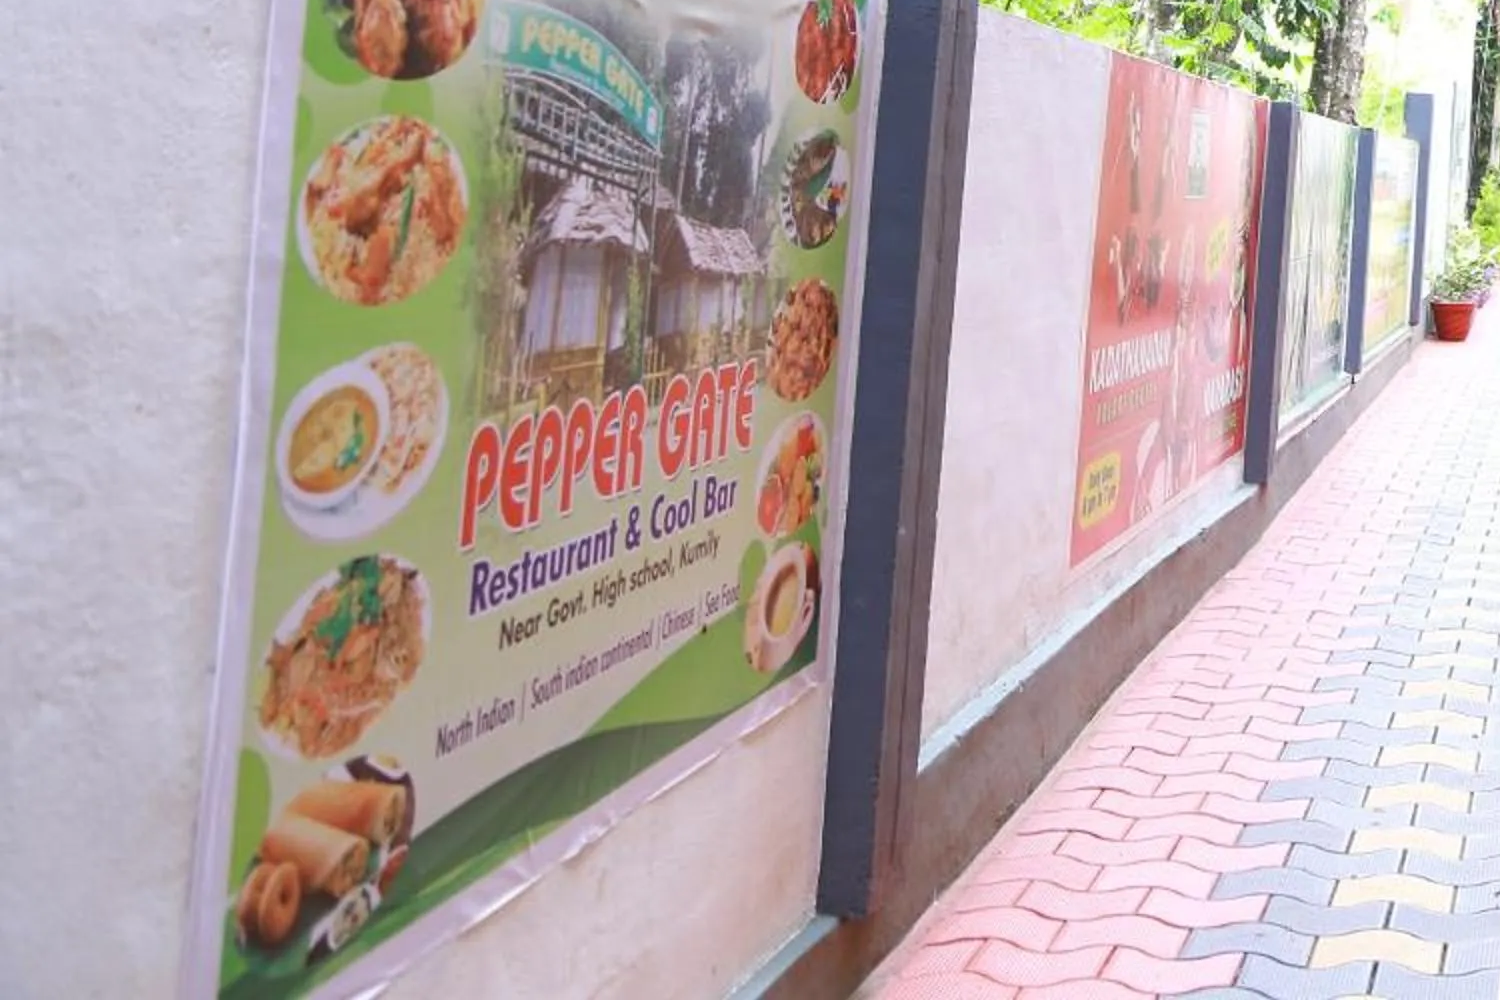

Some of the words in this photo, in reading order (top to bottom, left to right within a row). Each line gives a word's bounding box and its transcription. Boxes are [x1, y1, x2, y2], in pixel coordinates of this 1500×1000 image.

[459, 385, 648, 551] PEPPER
[657, 358, 757, 480] GATE
[469, 518, 618, 616] Restaurant
[625, 505, 641, 550] &
[651, 480, 698, 539] Cool
[703, 476, 737, 518] Bar
[499, 612, 541, 650] Near
[547, 593, 587, 629] Govt.
[592, 570, 627, 608] High
[629, 550, 675, 591] school,
[435, 711, 473, 758] North
[475, 697, 515, 738] Indian
[531, 665, 563, 709] South
